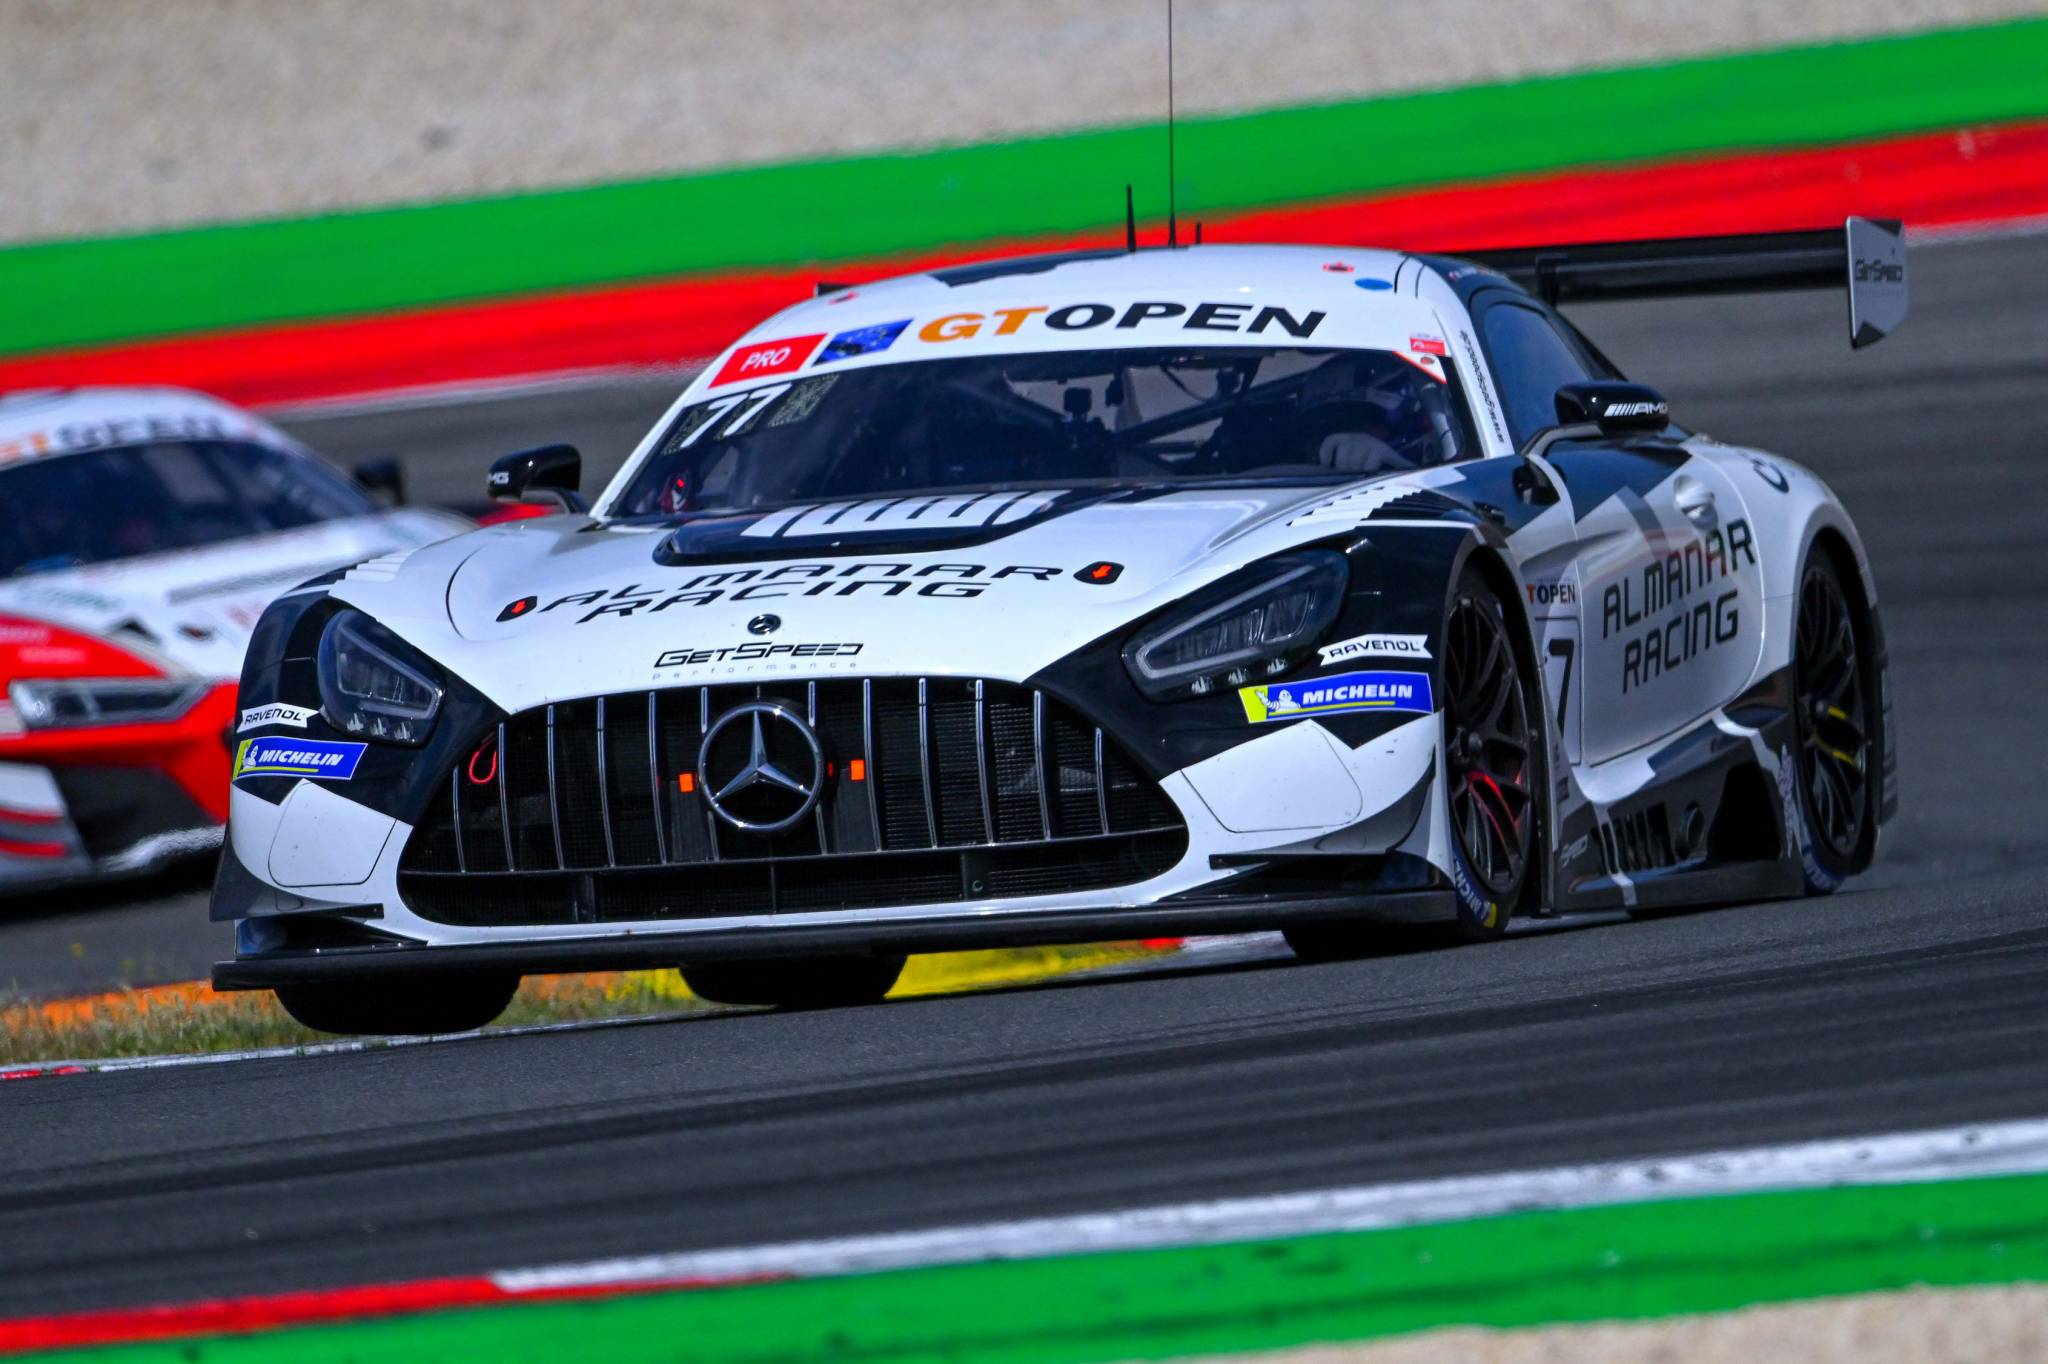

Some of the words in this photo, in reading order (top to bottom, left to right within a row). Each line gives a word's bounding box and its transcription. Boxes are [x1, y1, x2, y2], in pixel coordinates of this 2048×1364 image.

[740, 346, 791, 372] PRO
[679, 382, 792, 448] 77
[538, 564, 1063, 613] ALMANAR
[1603, 517, 1755, 639] ALMANAR
[575, 581, 991, 624] RACING
[1329, 640, 1420, 658] RAVENOL
[1622, 589, 1738, 694] RACING
[652, 661, 857, 680] performance
[1303, 684, 1413, 705] MICHELIN
[245, 708, 302, 725] RAVENOL
[258, 750, 344, 766] MICHELIN
